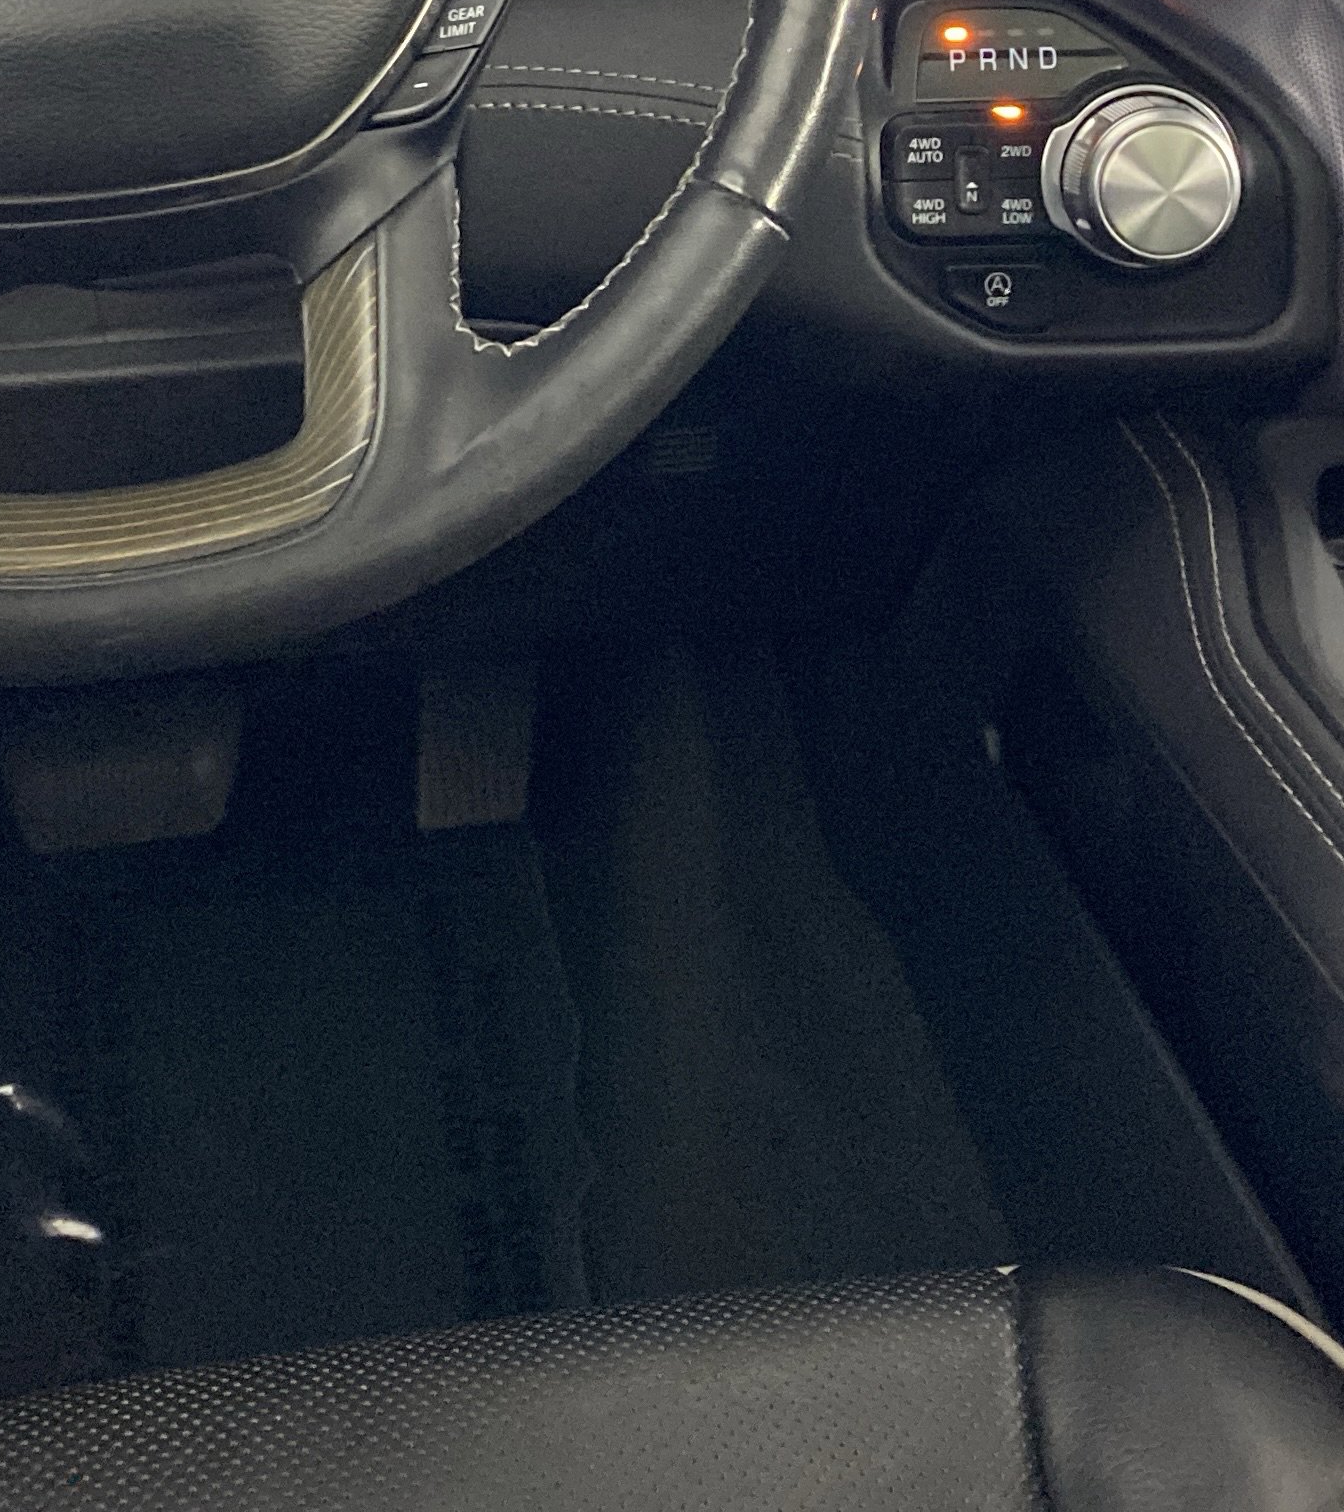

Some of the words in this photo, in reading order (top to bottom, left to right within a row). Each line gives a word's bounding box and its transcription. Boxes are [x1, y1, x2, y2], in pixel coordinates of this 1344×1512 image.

[447, 5, 485, 22] GEAR
[439, 22, 476, 38] LIMIT
[950, 49, 966, 71] P
[979, 48, 997, 71] R
[1009, 47, 1028, 70] N
[1039, 46, 1057, 70] D
[909, 138, 941, 149] 4WD
[907, 151, 943, 163] AUTO
[1000, 145, 1032, 158] 2WD
[966, 191, 977, 202] N
[913, 199, 945, 210] 4WD
[1001, 199, 1032, 210] 4WD
[912, 212, 946, 224] HIGH
[1003, 212, 1033, 224] LOW
[986, 297, 1009, 307] OFF
